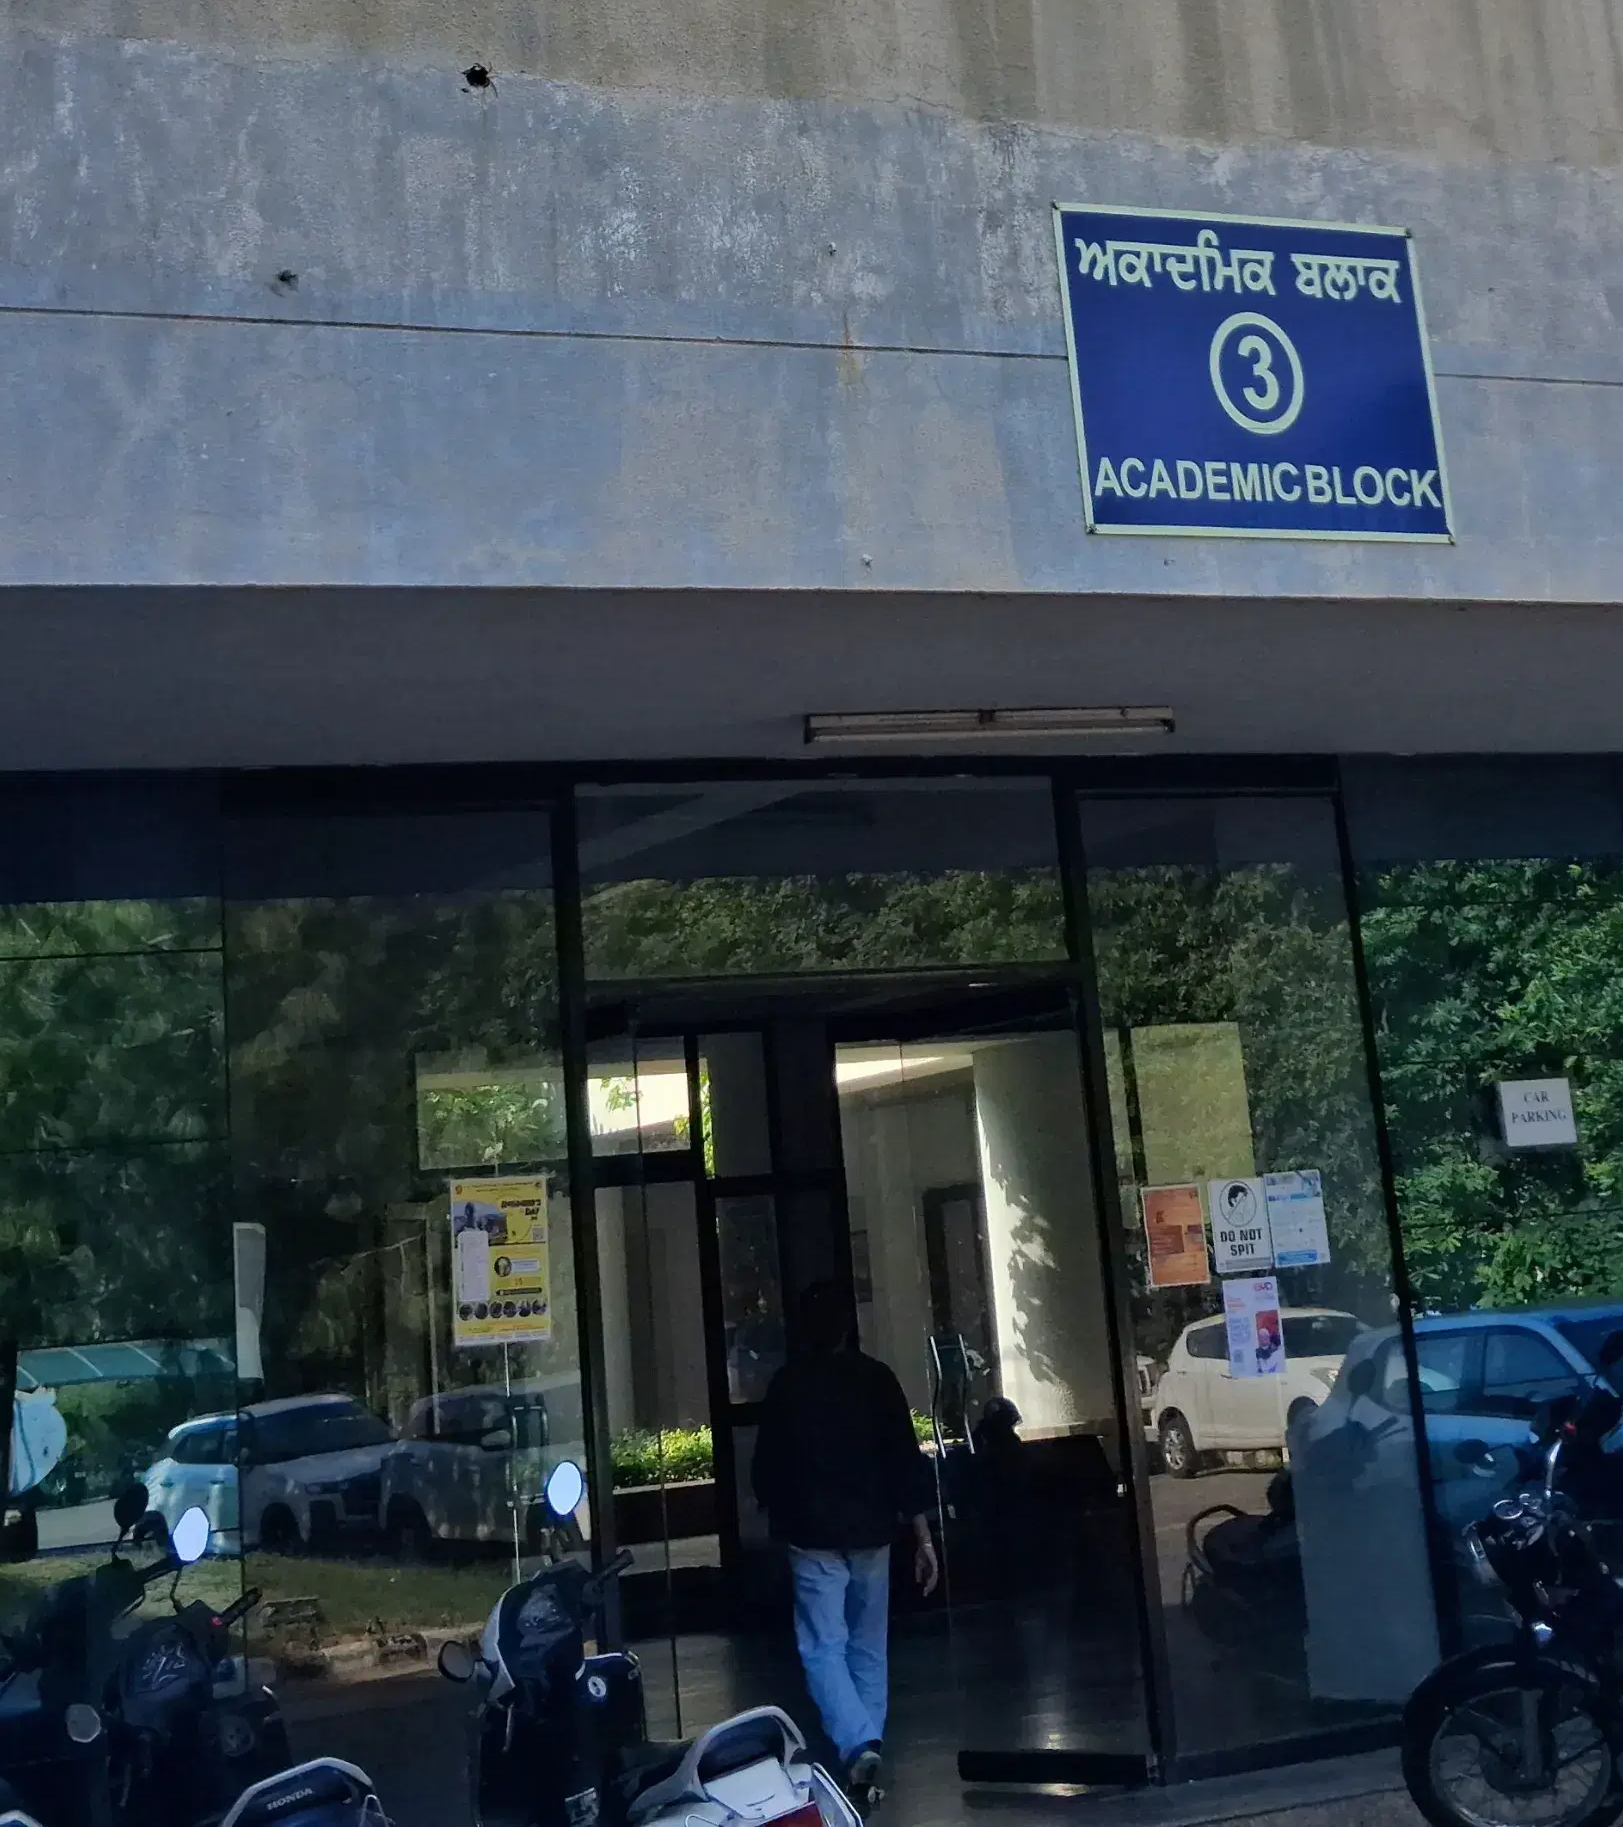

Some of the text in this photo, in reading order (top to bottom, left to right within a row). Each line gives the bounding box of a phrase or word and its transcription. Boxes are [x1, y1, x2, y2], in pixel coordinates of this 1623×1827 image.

[1290, 252, 1402, 304] ਬਲਾਕ
[1237, 334, 1280, 411] 3
[1094, 456, 1443, 509] ACADEMIC BLOCK
[1523, 1089, 1550, 1104] CAR
[1511, 1109, 1567, 1125] PARKING
[1220, 1228, 1263, 1243] DO NOT
[1229, 1243, 1256, 1257] SPIT
[266, 1787, 314, 1811] HONDA
